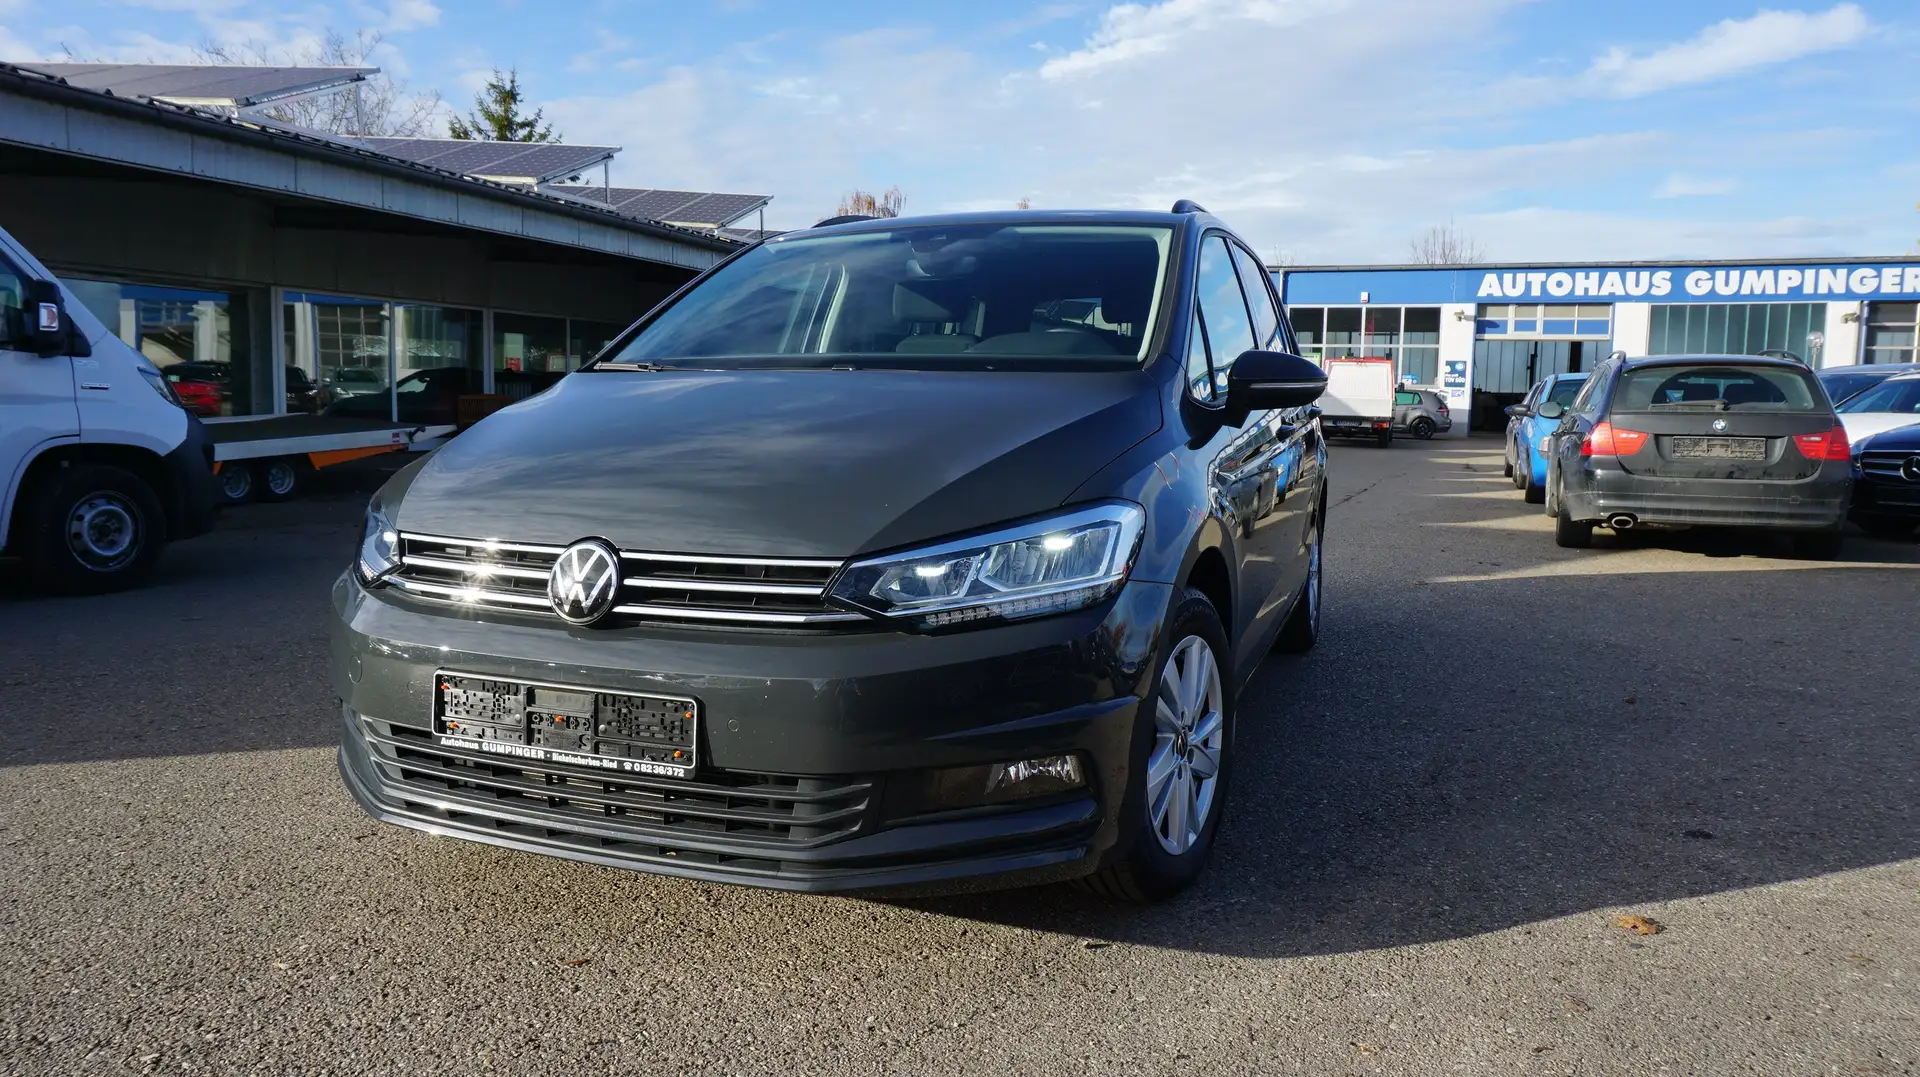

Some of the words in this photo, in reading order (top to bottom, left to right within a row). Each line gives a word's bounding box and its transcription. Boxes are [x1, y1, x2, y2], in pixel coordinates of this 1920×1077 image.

[1477, 271, 1673, 297] AUTOHAUS
[1684, 267, 1920, 296] GUMPINGER
[440, 737, 480, 750] Autohaus
[482, 740, 545, 760] GUMPINGER
